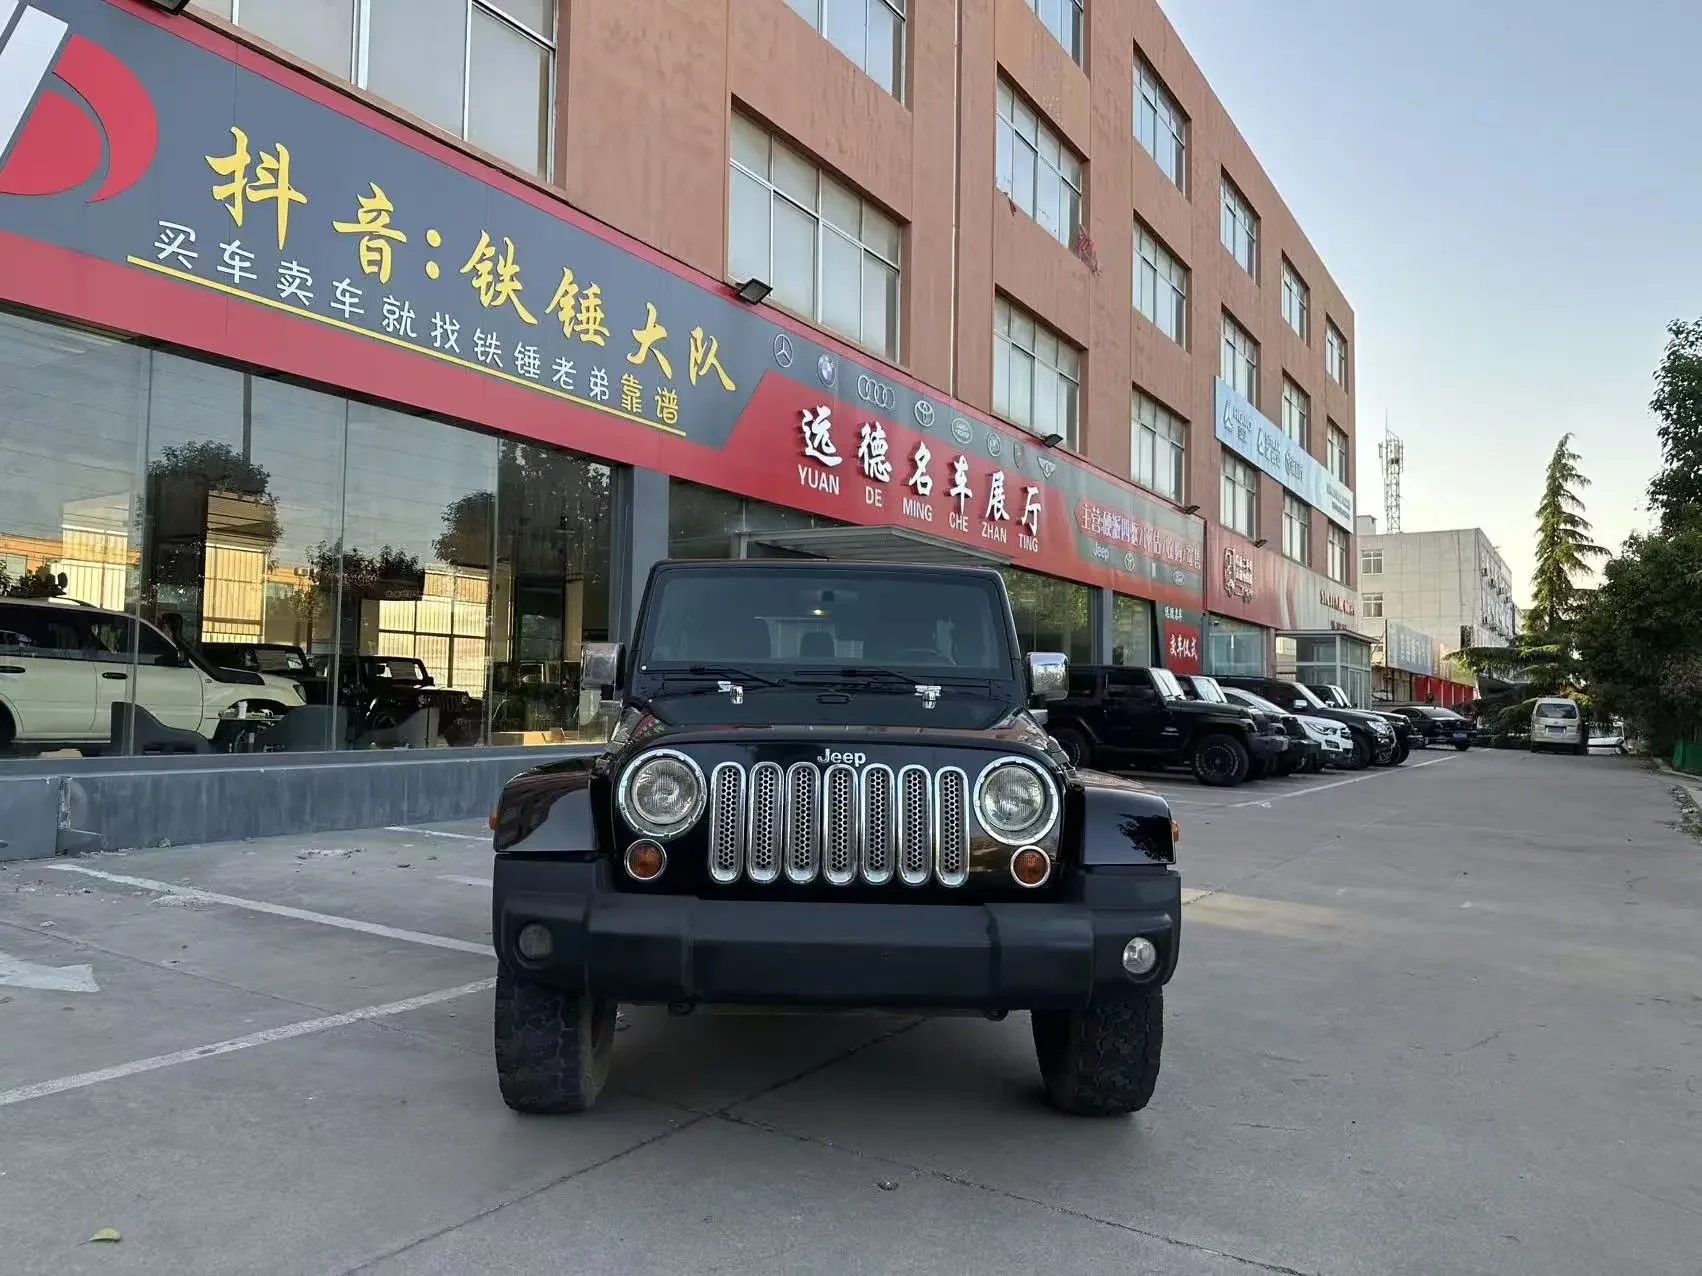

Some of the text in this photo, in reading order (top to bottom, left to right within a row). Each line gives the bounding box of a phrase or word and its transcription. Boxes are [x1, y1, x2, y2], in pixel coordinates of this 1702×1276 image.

[154, 220, 681, 424] 买车卖车就找铁锤老弟靠谱
[798, 465, 1038, 552] YUAN DE MING CHE ZHAN TING
[801, 404, 1043, 536] 远德名车展厅
[1093, 541, 1110, 561] Jeep
[817, 748, 867, 767] Jeep
